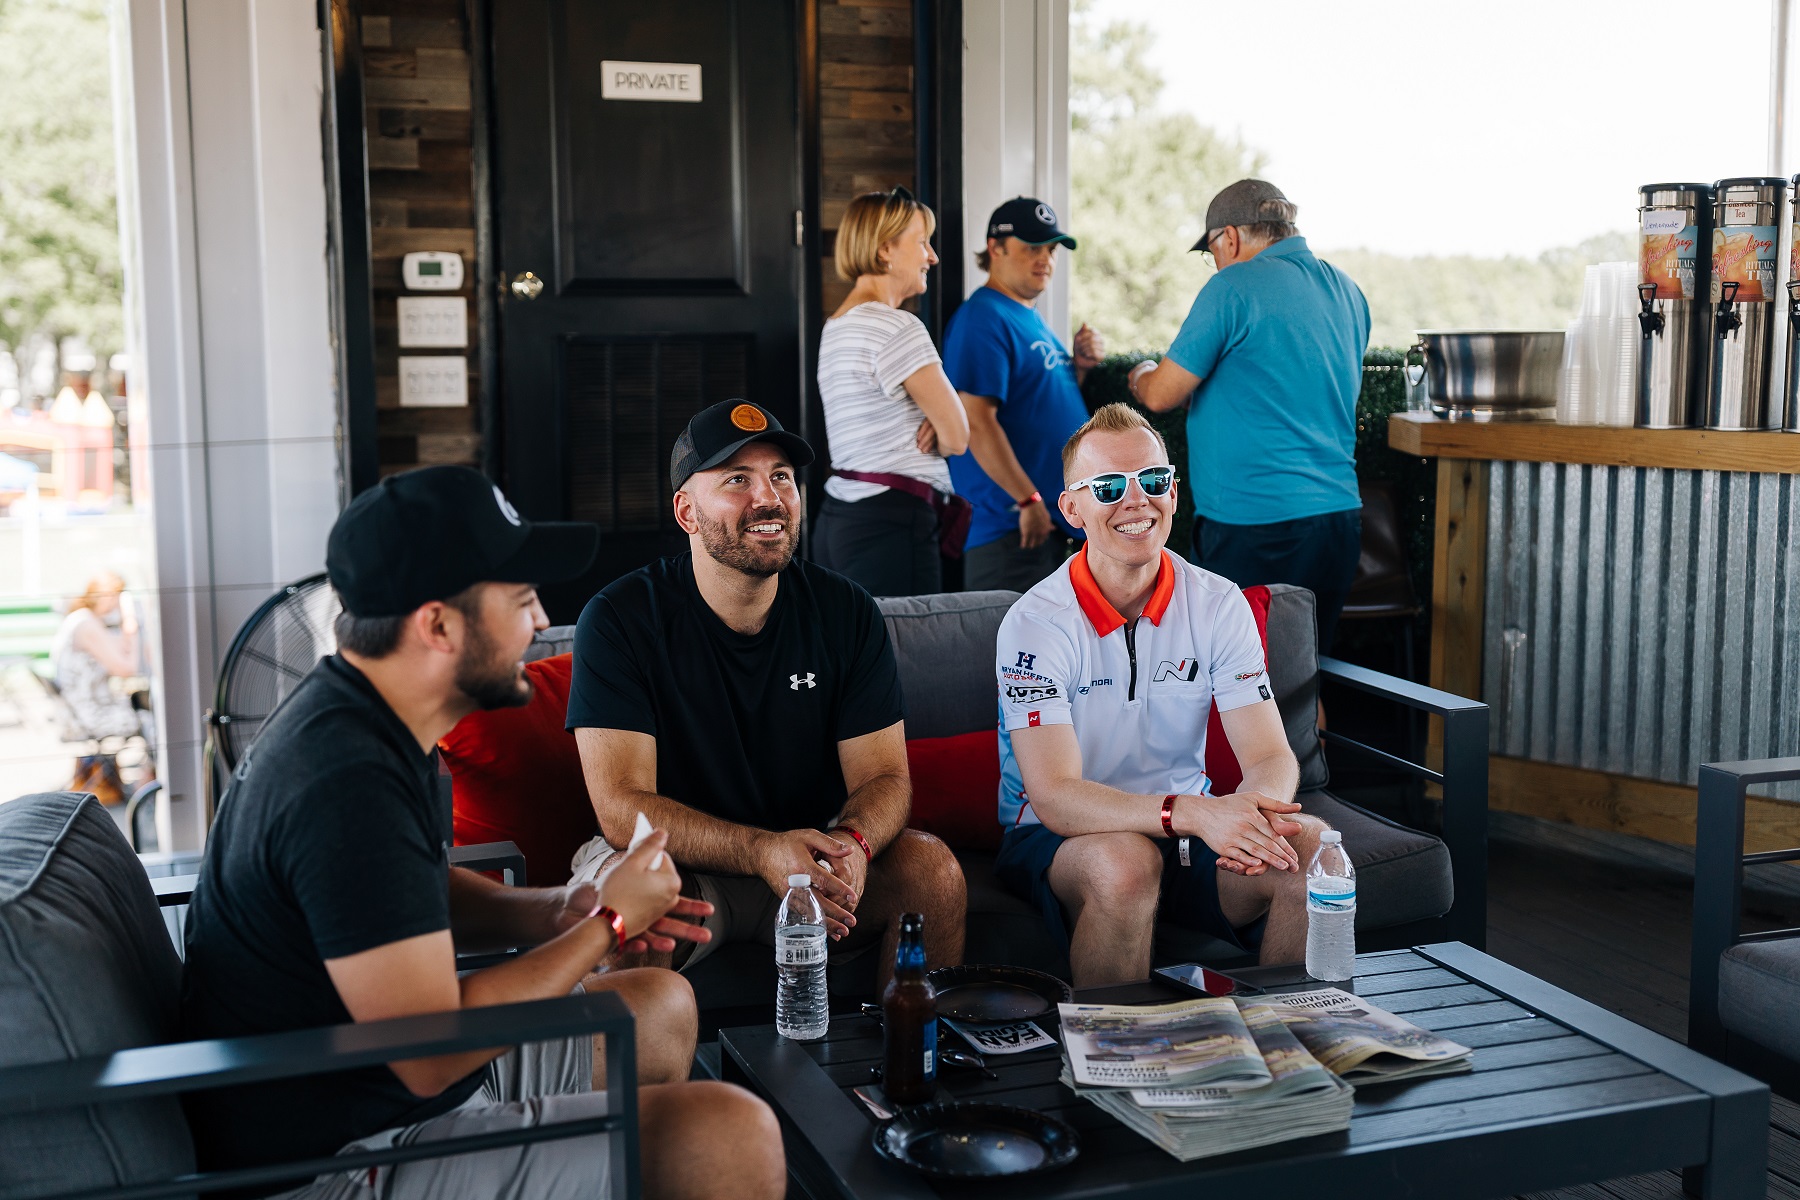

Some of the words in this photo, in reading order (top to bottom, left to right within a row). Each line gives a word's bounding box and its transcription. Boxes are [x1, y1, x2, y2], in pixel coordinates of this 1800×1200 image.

[615, 71, 690, 91] PRIVATE
[1735, 209, 1746, 218] Tea
[1645, 219, 1680, 230] Lemonade
[1666, 259, 1695, 268] RITUALS
[1745, 261, 1775, 270] RITUALS
[1666, 268, 1695, 279] TEA
[1745, 270, 1775, 281] TEA
[1024, 670, 1053, 684] HERTA
[1282, 993, 1342, 1006] SOUVENIR
[967, 1023, 1030, 1037] GUIDE
[973, 1028, 1041, 1046] FAN
